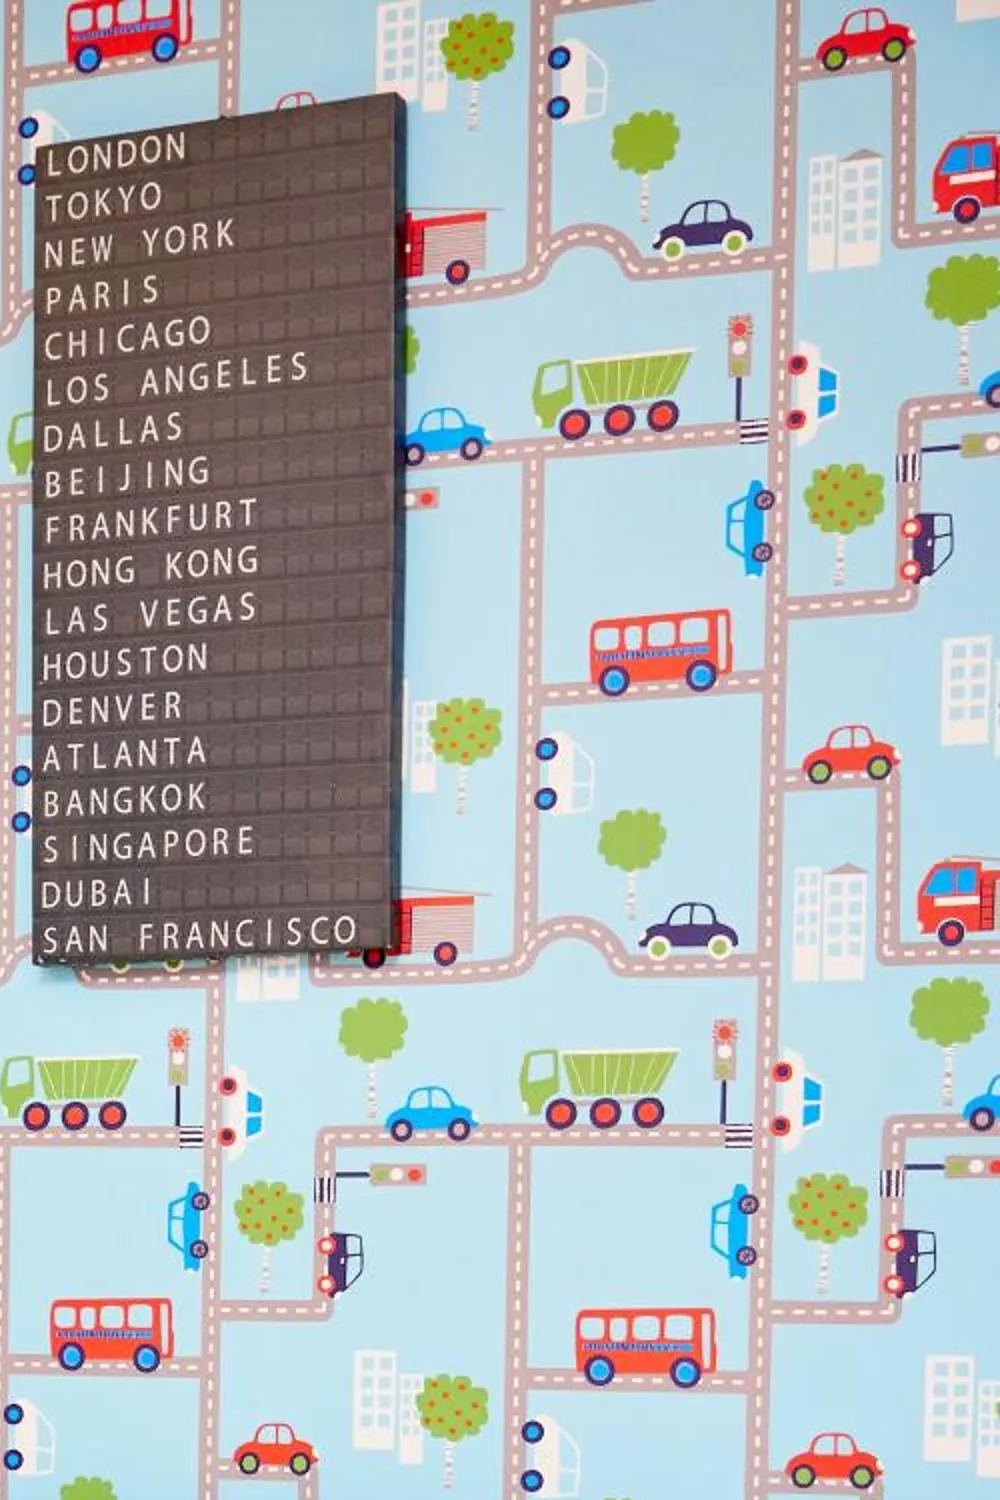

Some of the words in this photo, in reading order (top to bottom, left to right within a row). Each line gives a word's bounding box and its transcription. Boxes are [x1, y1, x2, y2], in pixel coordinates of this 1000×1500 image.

[48, 133, 186, 177] LONDON
[46, 182, 161, 222] TOKYO
[45, 235, 113, 269] NEW
[142, 219, 235, 258] YORK
[47, 275, 158, 315] PARIS
[45, 316, 210, 361] CHICAGO
[47, 373, 109, 406] LOS
[140, 352, 307, 397] ANGELES
[44, 412, 182, 453] DALLAS
[45, 456, 209, 500] BEIJING
[46, 498, 257, 544] FRANKFURT
[43, 556, 135, 590] HONG
[166, 546, 258, 581] KONG
[46, 603, 108, 635] LAS
[139, 592, 256, 628] VEGAS
[43, 643, 208, 681] HOUSTON
[43, 692, 182, 727] DENVER
[42, 736, 206, 772] ATLANTA
[44, 783, 206, 818] BANGKOK
[43, 826, 254, 863] SINGAPORE
[42, 878, 149, 909] DUBAI
[43, 926, 107, 954] SAN
[139, 916, 356, 951] FRANCISCO
